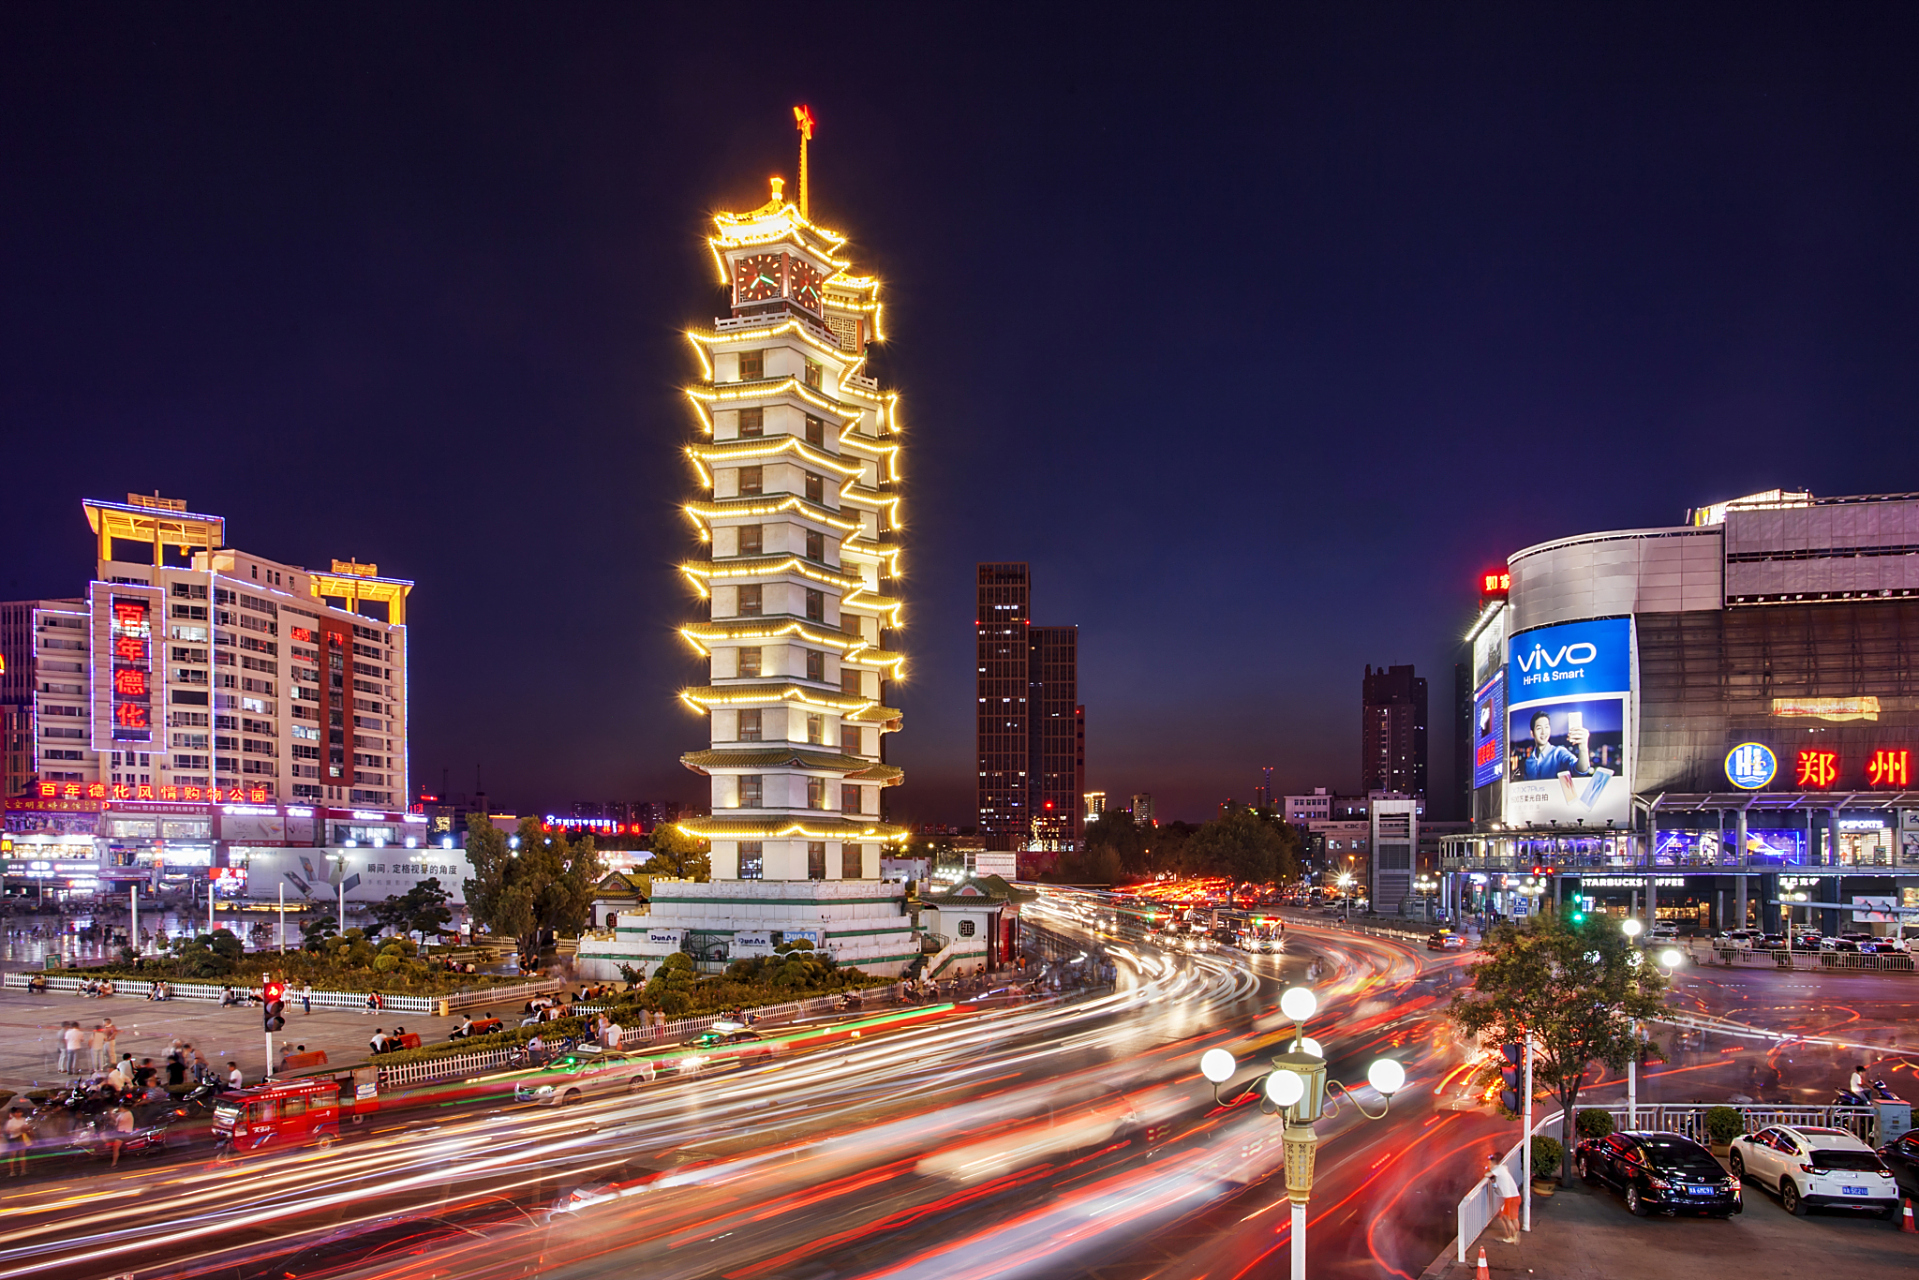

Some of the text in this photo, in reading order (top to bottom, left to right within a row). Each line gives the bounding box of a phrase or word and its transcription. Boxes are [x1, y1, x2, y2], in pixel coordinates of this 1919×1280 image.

[114, 604, 146, 728] 百年德化
[1517, 642, 1598, 673] vivo
[1523, 668, 1585, 686] Hi-Fi & Smart
[1797, 750, 1908, 787] 郑州
[40, 782, 266, 803] 百年德化风情购物公园
